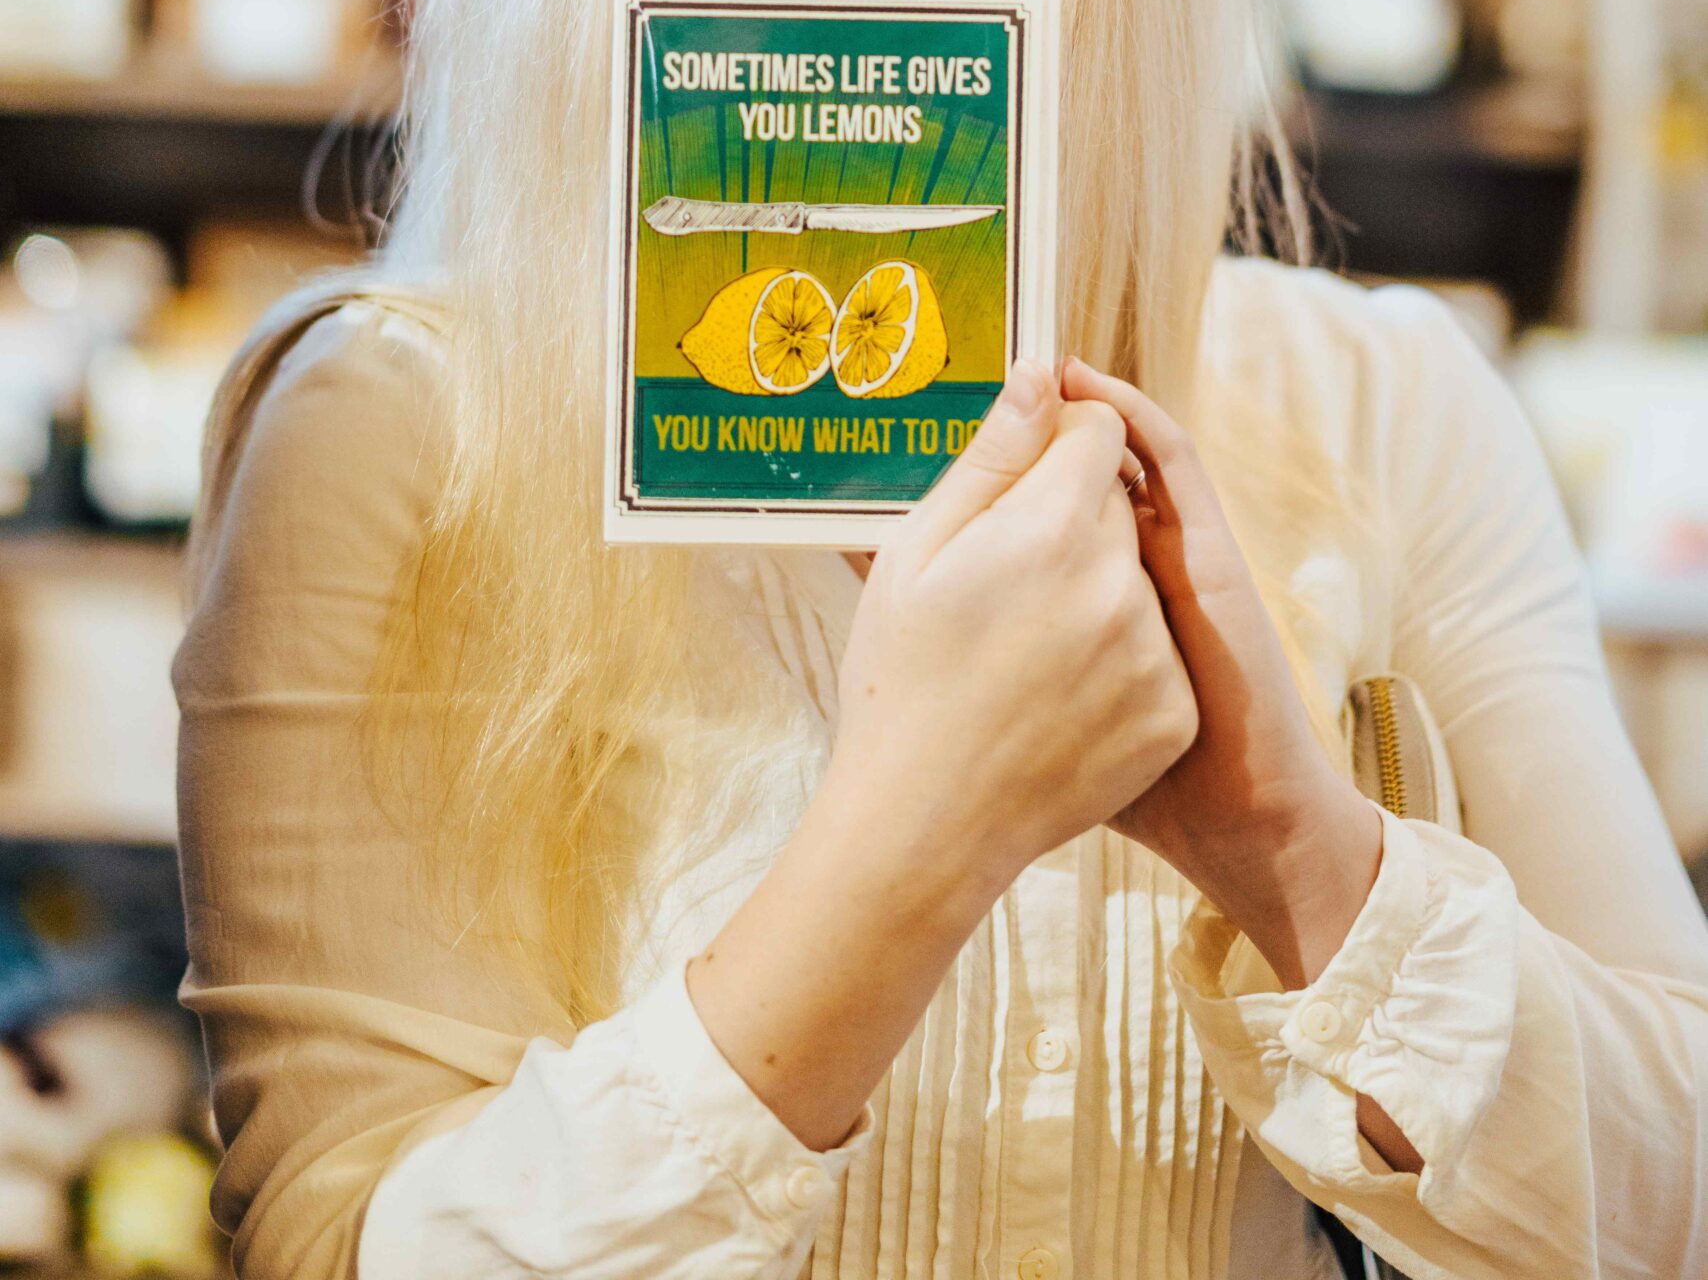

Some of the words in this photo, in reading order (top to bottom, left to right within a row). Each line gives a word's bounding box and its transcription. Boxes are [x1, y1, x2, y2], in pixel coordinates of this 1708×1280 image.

[662, 51, 835, 94] SOMETIMES
[840, 54, 902, 95] LIFE
[907, 56, 992, 96] GIVES
[738, 102, 796, 141] YOU
[802, 104, 922, 143] LEMONS
[653, 414, 710, 451] YOU
[718, 415, 804, 453] KNOW
[813, 417, 896, 454] WHAT
[902, 418, 939, 456] TO
